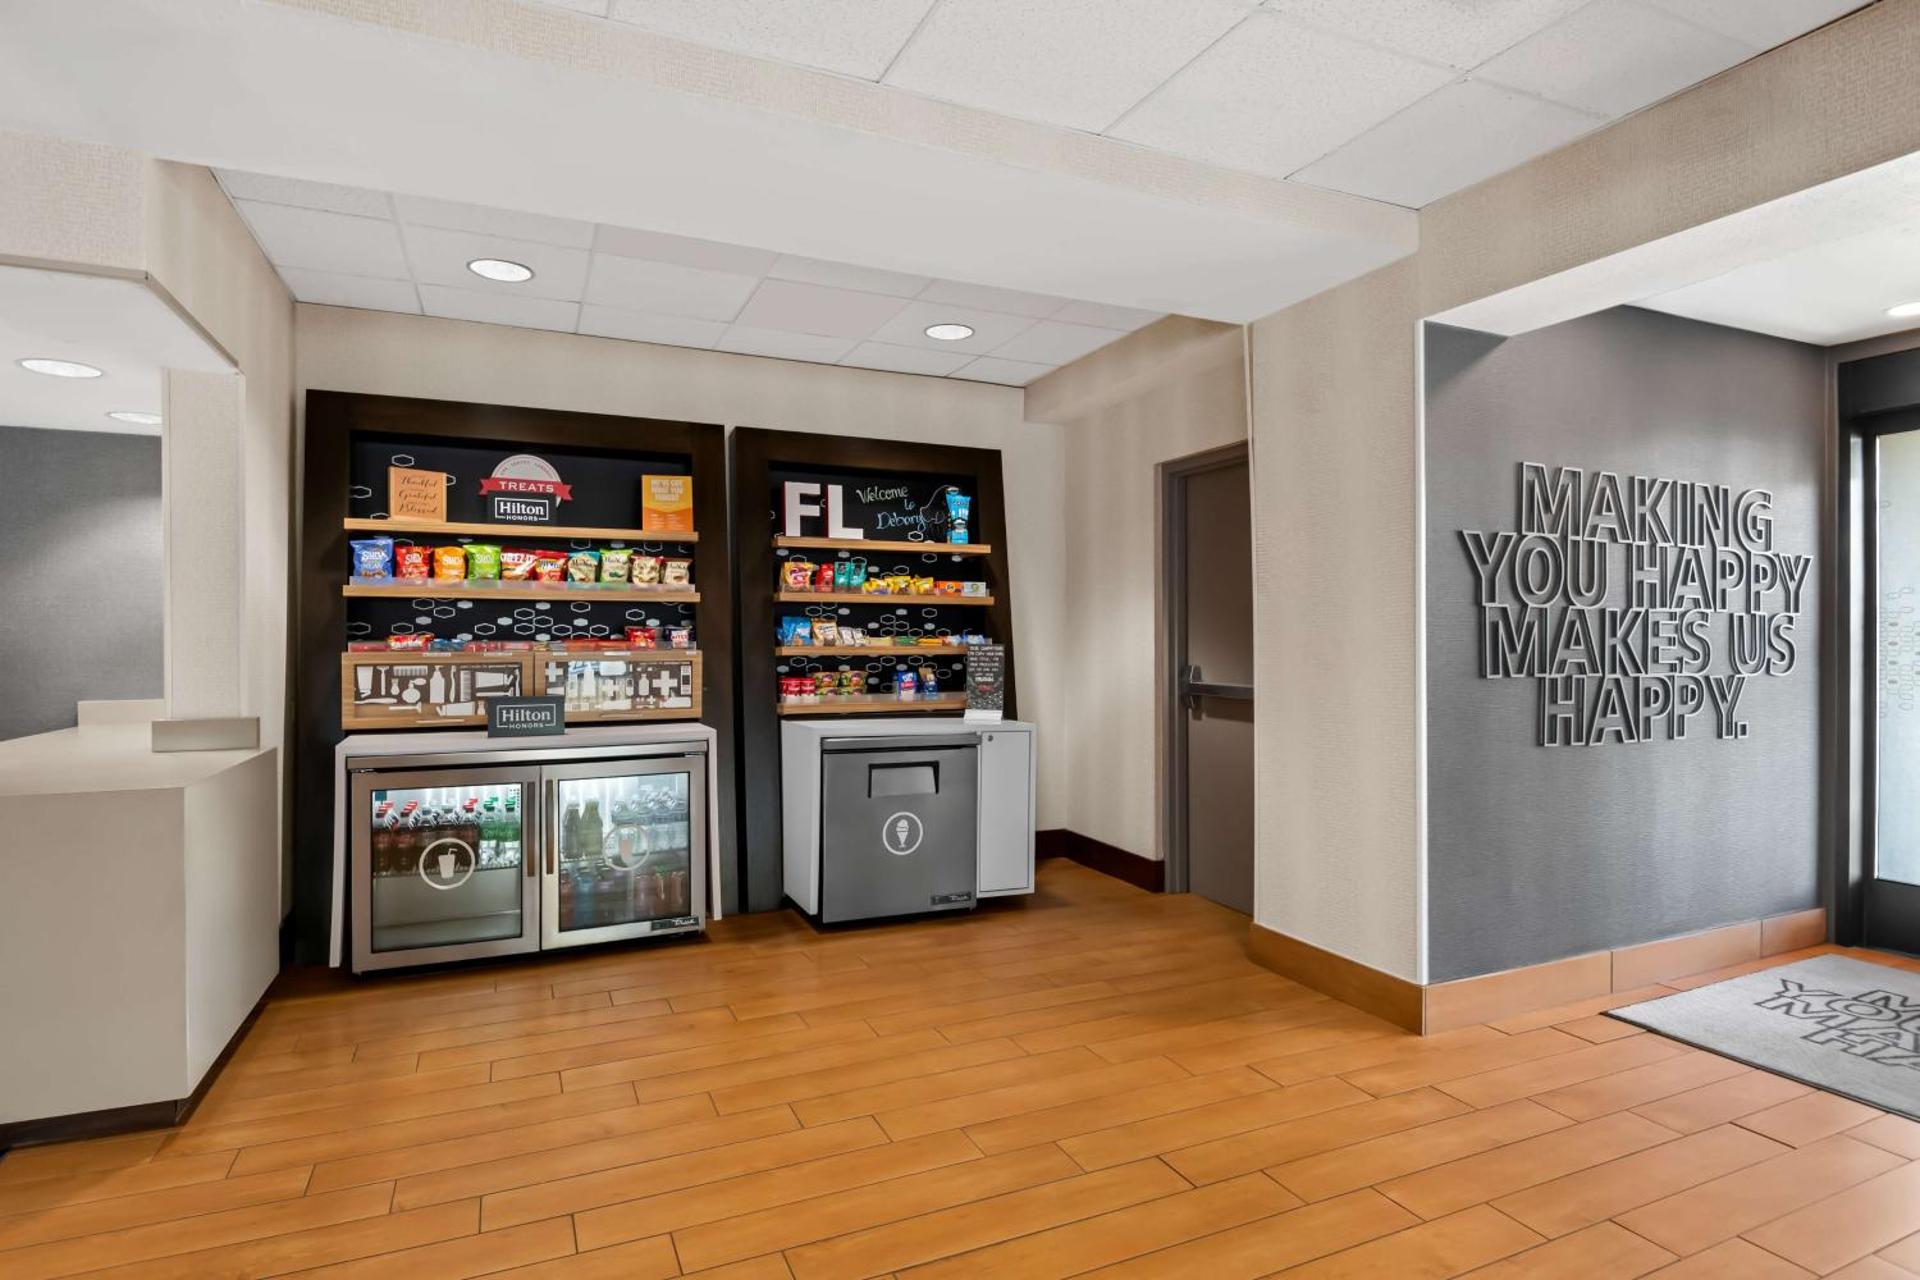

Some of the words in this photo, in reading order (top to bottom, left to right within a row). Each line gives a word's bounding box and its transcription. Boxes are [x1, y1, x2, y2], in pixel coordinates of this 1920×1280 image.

[499, 481, 554, 493] TREATS
[856, 486, 909, 504] Welcome
[500, 502, 545, 515] Hilton
[904, 499, 916, 511] to
[1518, 461, 1773, 552] MAKING
[1459, 530, 1609, 608] YOU
[1630, 543, 1813, 613] HAPPY
[1484, 604, 1711, 679] MAKES
[1730, 611, 1796, 677] US
[502, 708, 552, 723] Hilton
[1543, 674, 1749, 747] HAPPY.
[509, 723, 545, 731] HONORS
